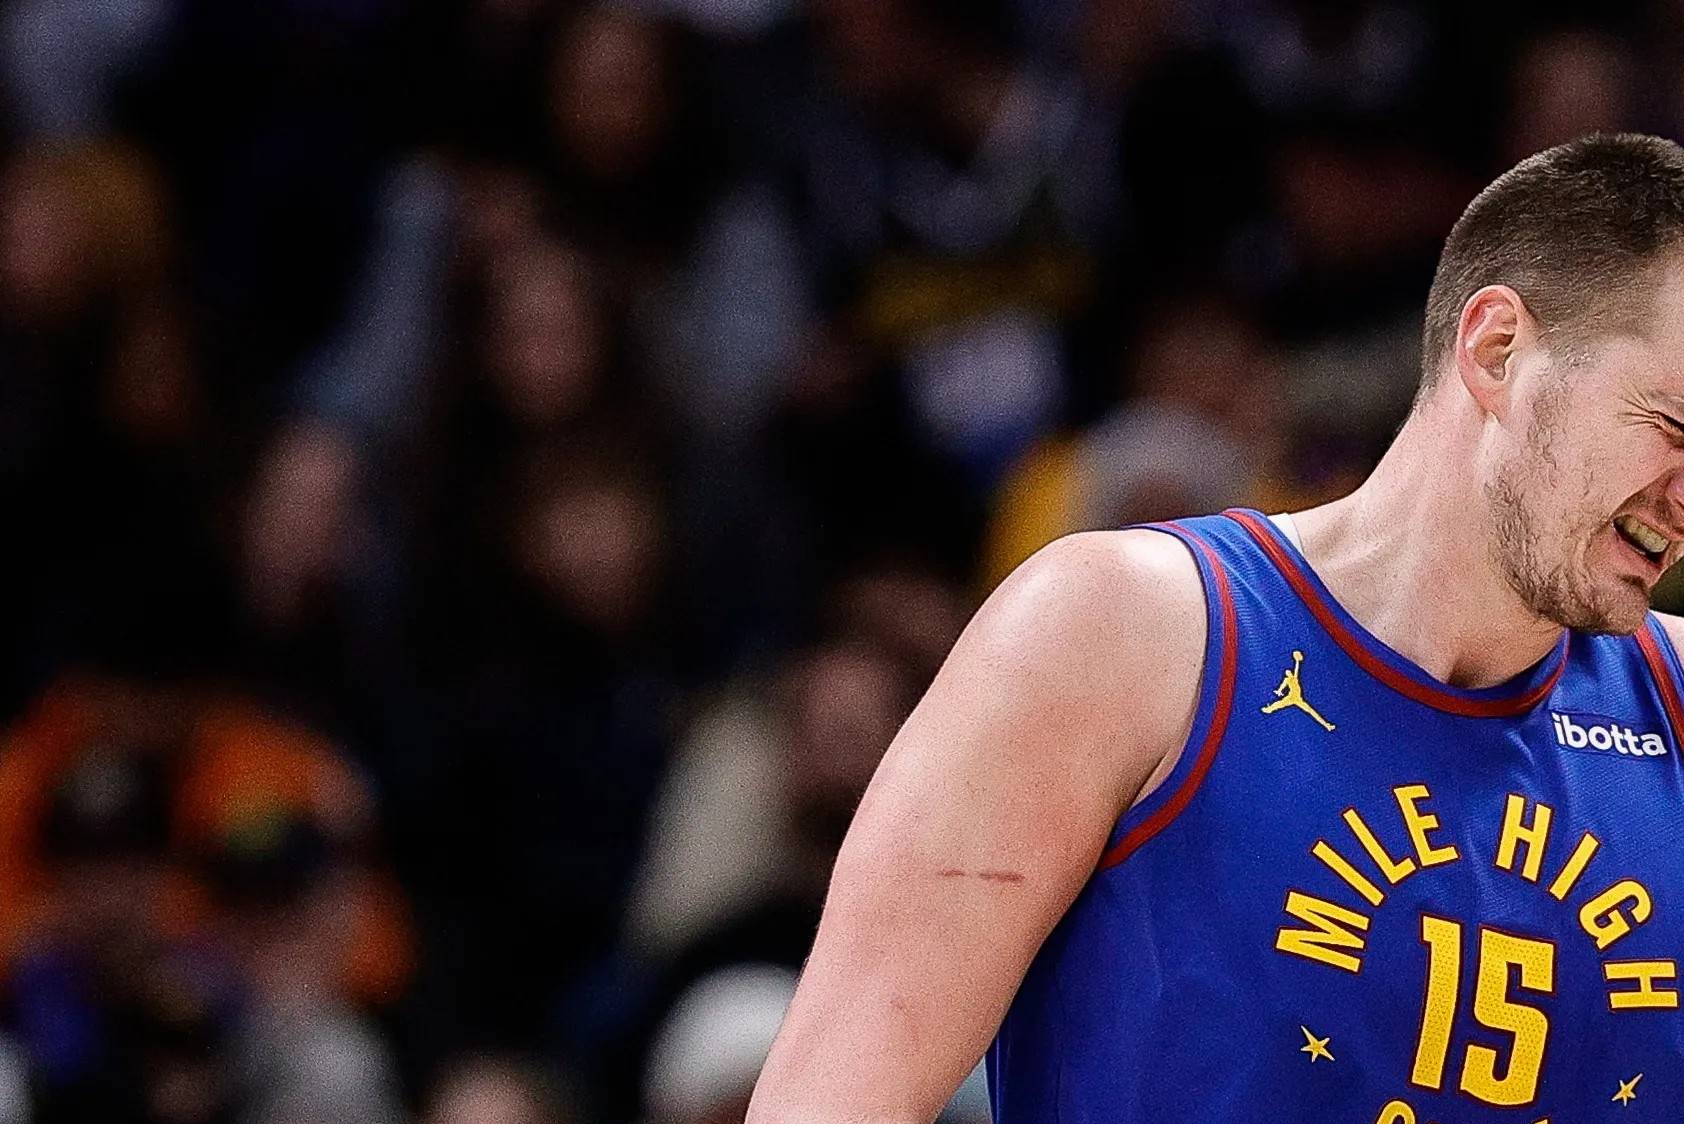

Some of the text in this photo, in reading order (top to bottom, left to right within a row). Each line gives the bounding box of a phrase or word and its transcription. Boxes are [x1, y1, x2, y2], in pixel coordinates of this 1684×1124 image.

[1552, 712, 1668, 758] ibotta
[1274, 783, 1680, 1011] MILE HIGH
[1410, 914, 1556, 1107] 15
